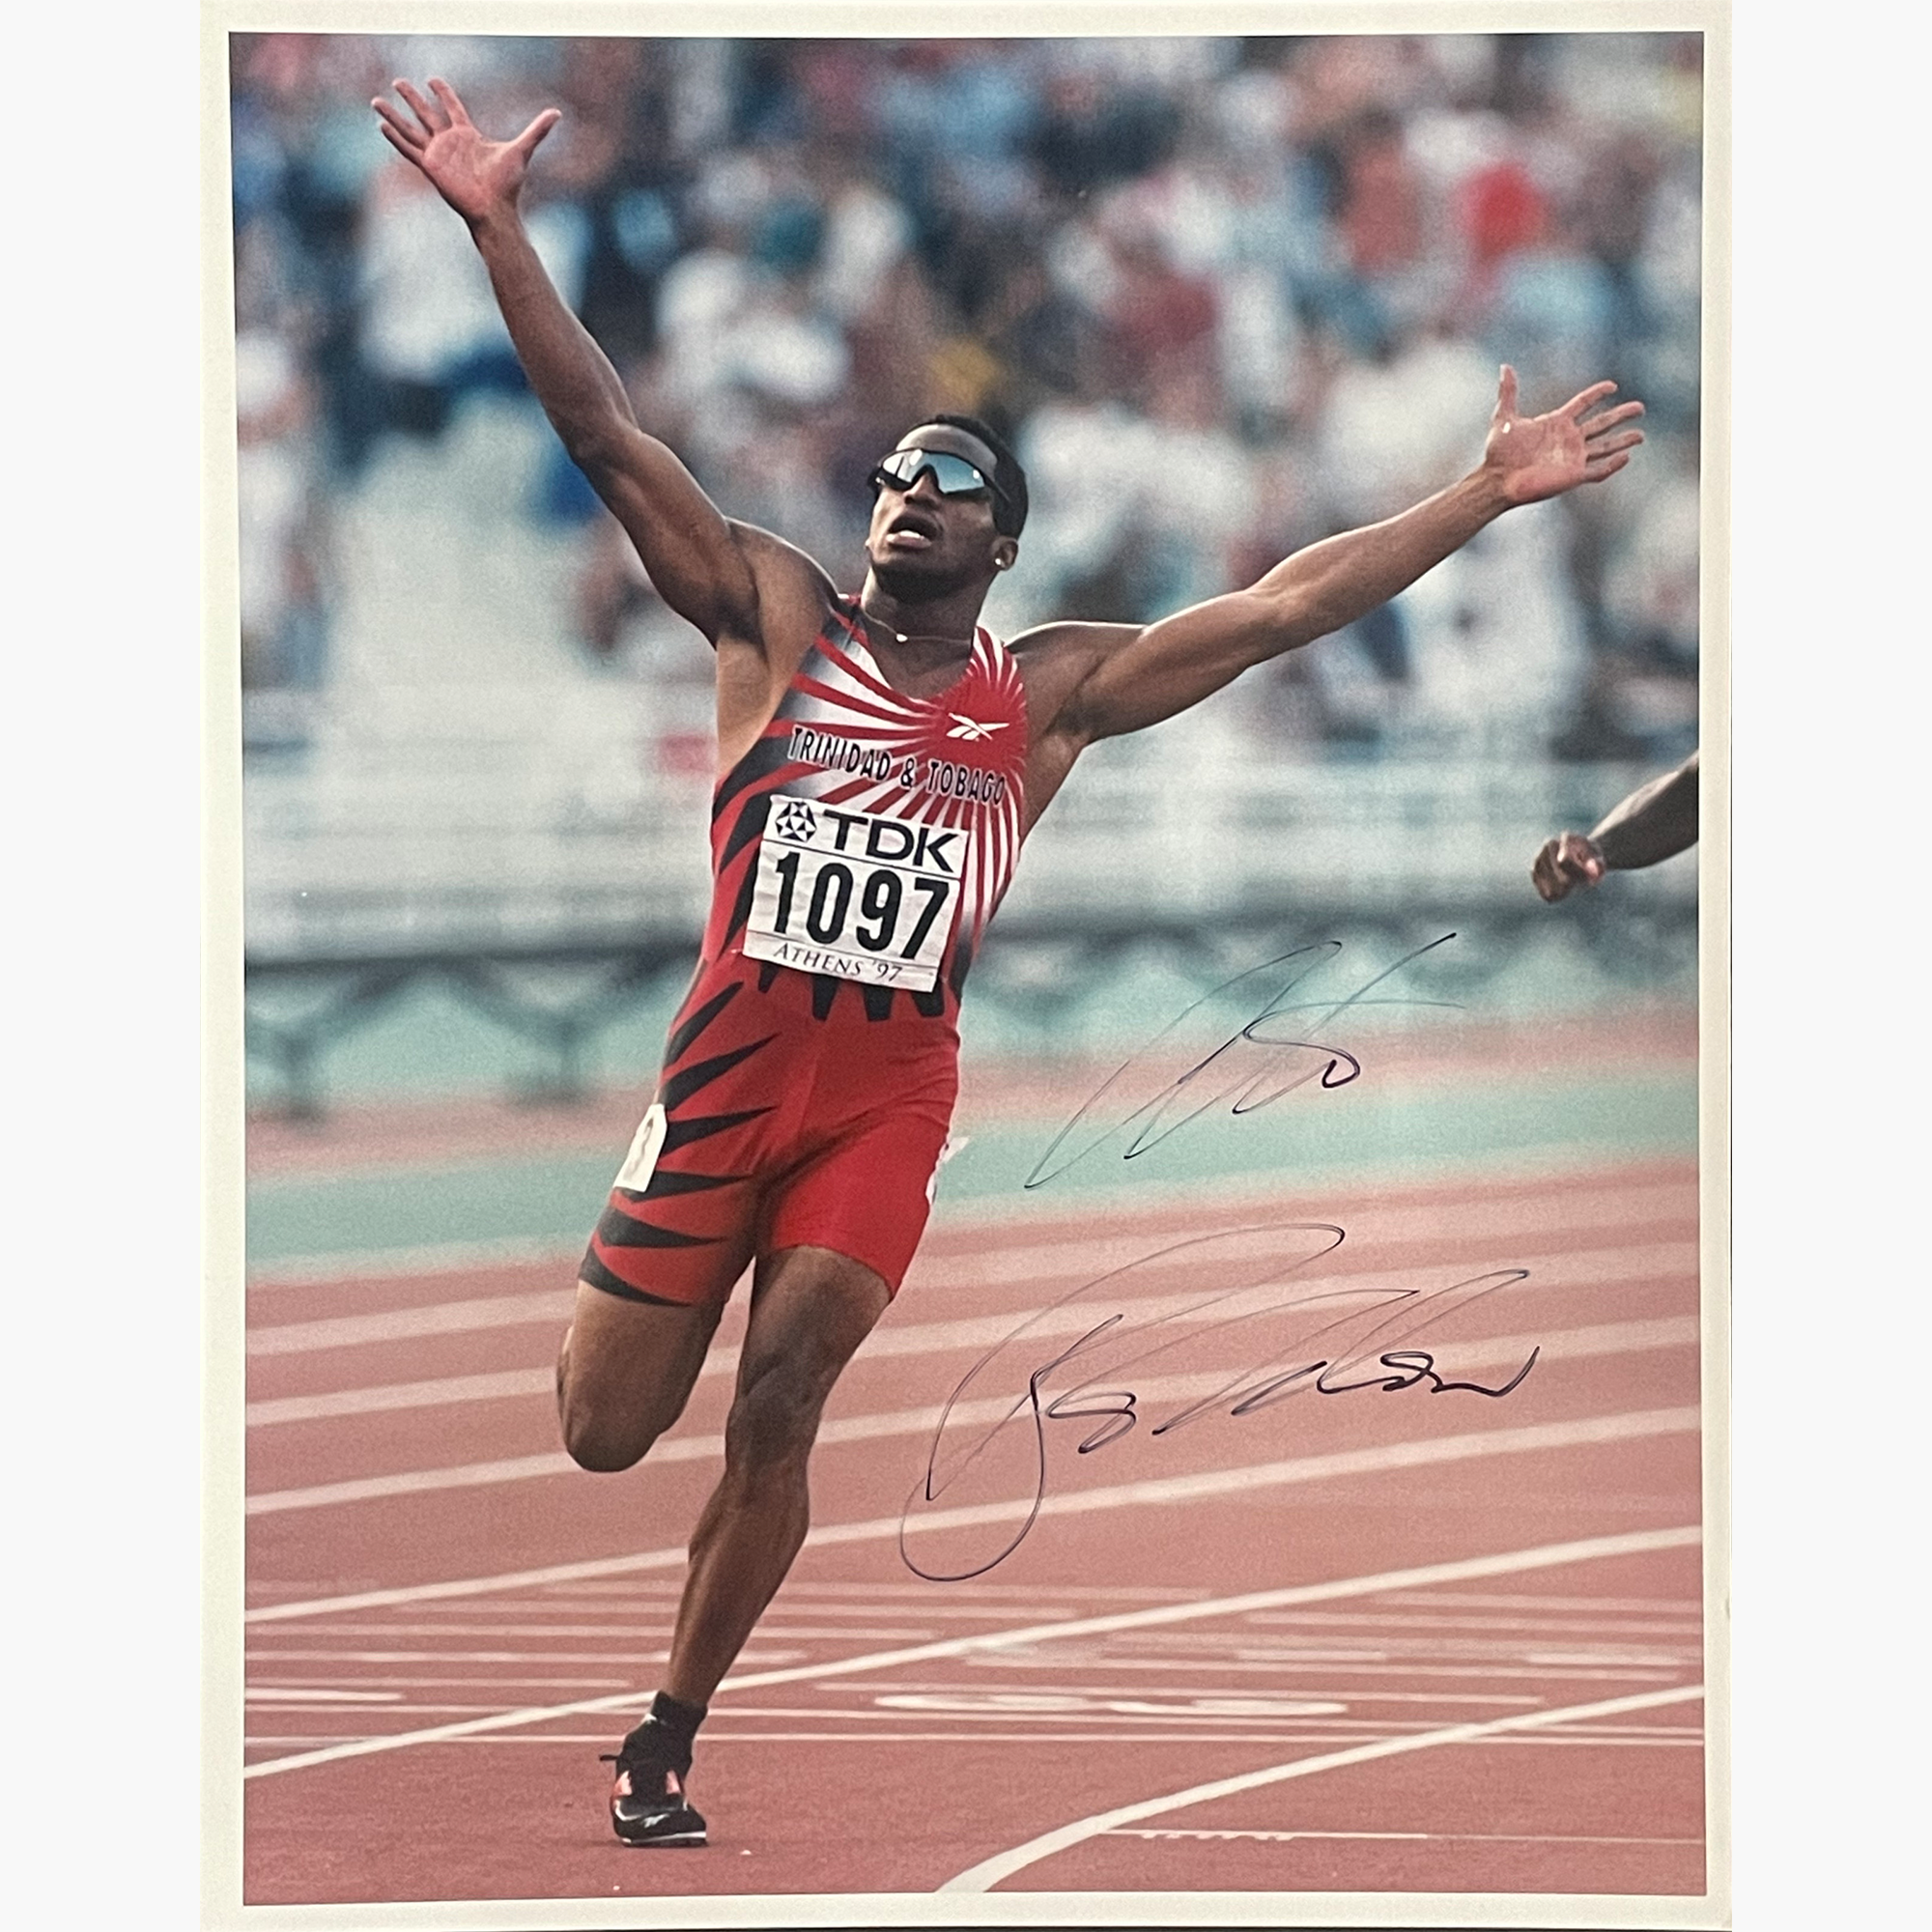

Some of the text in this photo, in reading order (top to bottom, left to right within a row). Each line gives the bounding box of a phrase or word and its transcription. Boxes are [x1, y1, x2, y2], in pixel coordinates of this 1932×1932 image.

[787, 724, 1006, 806] TRINIDAD & TOBAGO
[823, 810, 958, 872] TDK
[774, 852, 950, 960] 1097
[774, 942, 903, 982] ATHENS '97
